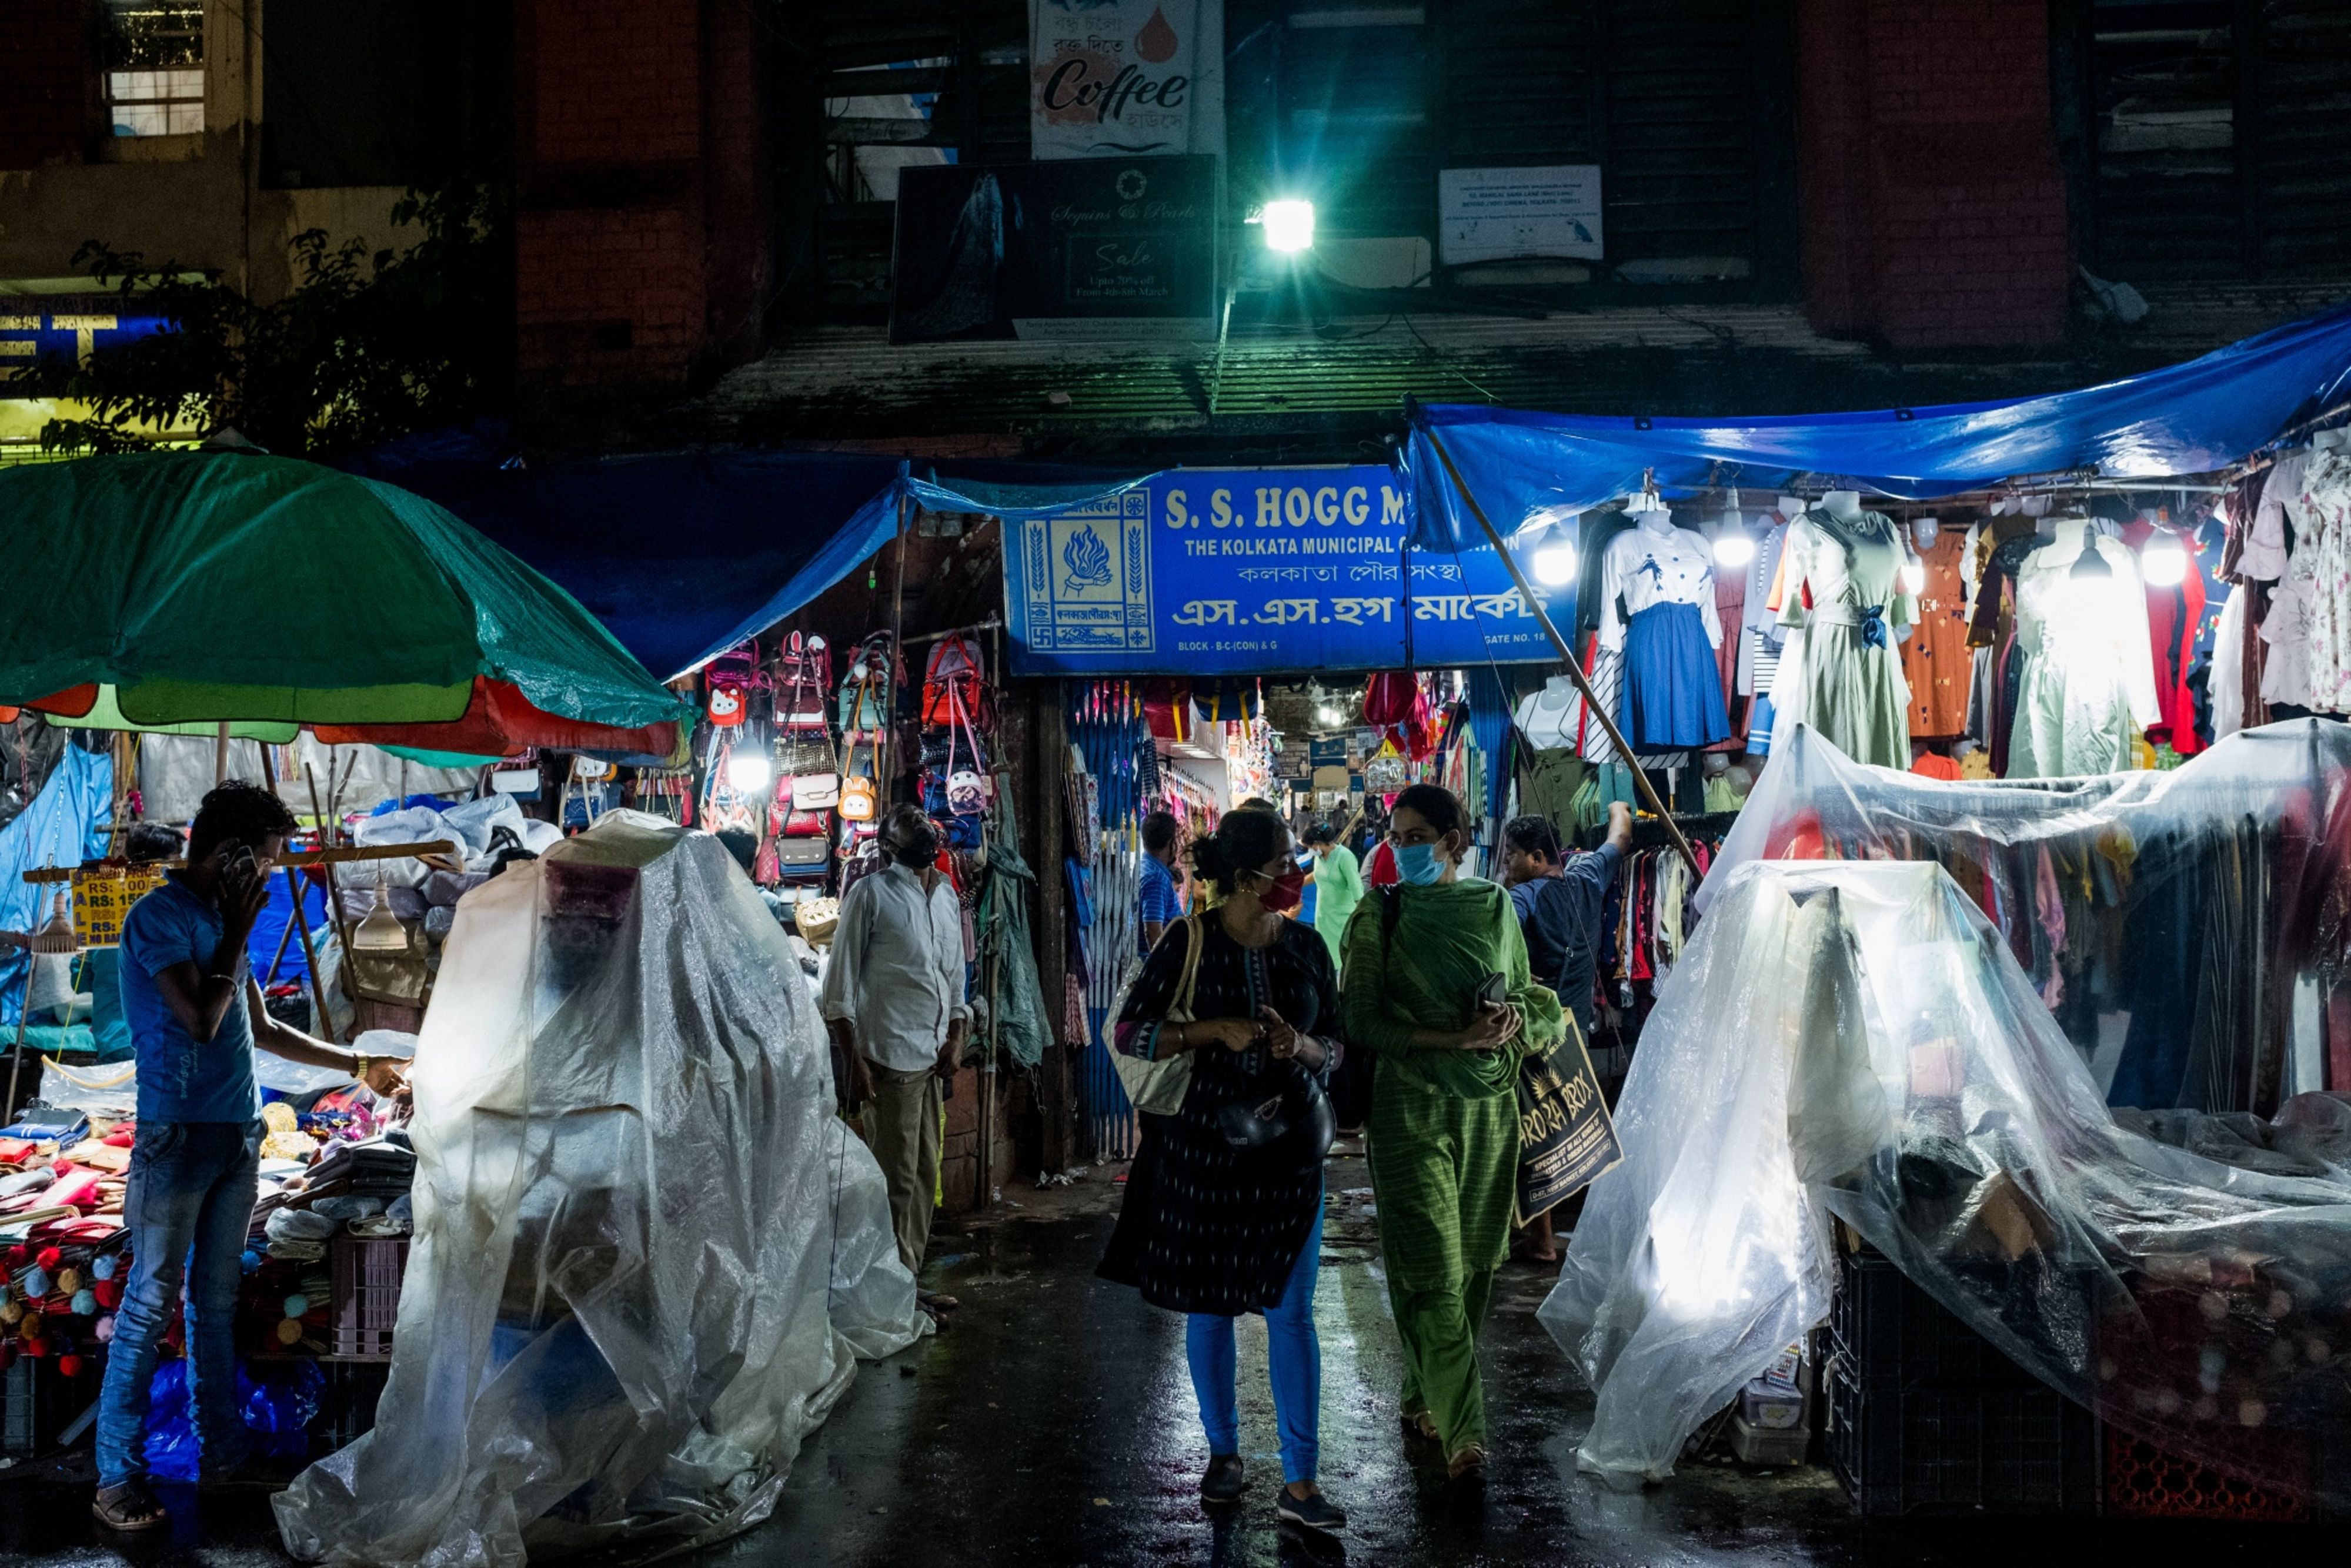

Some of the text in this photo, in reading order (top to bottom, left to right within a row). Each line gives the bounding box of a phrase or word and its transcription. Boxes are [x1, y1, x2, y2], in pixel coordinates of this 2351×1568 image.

[1086, 35, 1124, 53] দিতে
[1043, 58, 1188, 124] Coffee
[1096, 240, 1154, 271] Sale
[1090, 276, 1114, 287] Upto
[1166, 489, 1200, 529] S.
[1210, 489, 1244, 528] S.
[1255, 486, 1370, 527] HOGG
[1185, 540, 1217, 556] THE
[1222, 539, 1298, 555] KOLKATA
[1302, 537, 1394, 554] MUNICIPAL
[1236, 560, 1462, 583] কলকাতা পৌর সংস্থা
[1178, 641, 1208, 651] BLOCK
[1261, 641, 1268, 650] &
[1270, 640, 1277, 650] G
[1485, 633, 1545, 644] GATE NO. 18
[89, 882, 113, 894] RS:
[73, 870, 87, 946] SALE
[89, 895, 115, 908] RS:
[91, 908, 116, 921] RS:
[91, 921, 116, 932] RS:
[89, 934, 102, 944] NO
[1534, 1146, 1567, 1171] SPECIALIST
[1573, 1135, 1582, 1148] ALL
